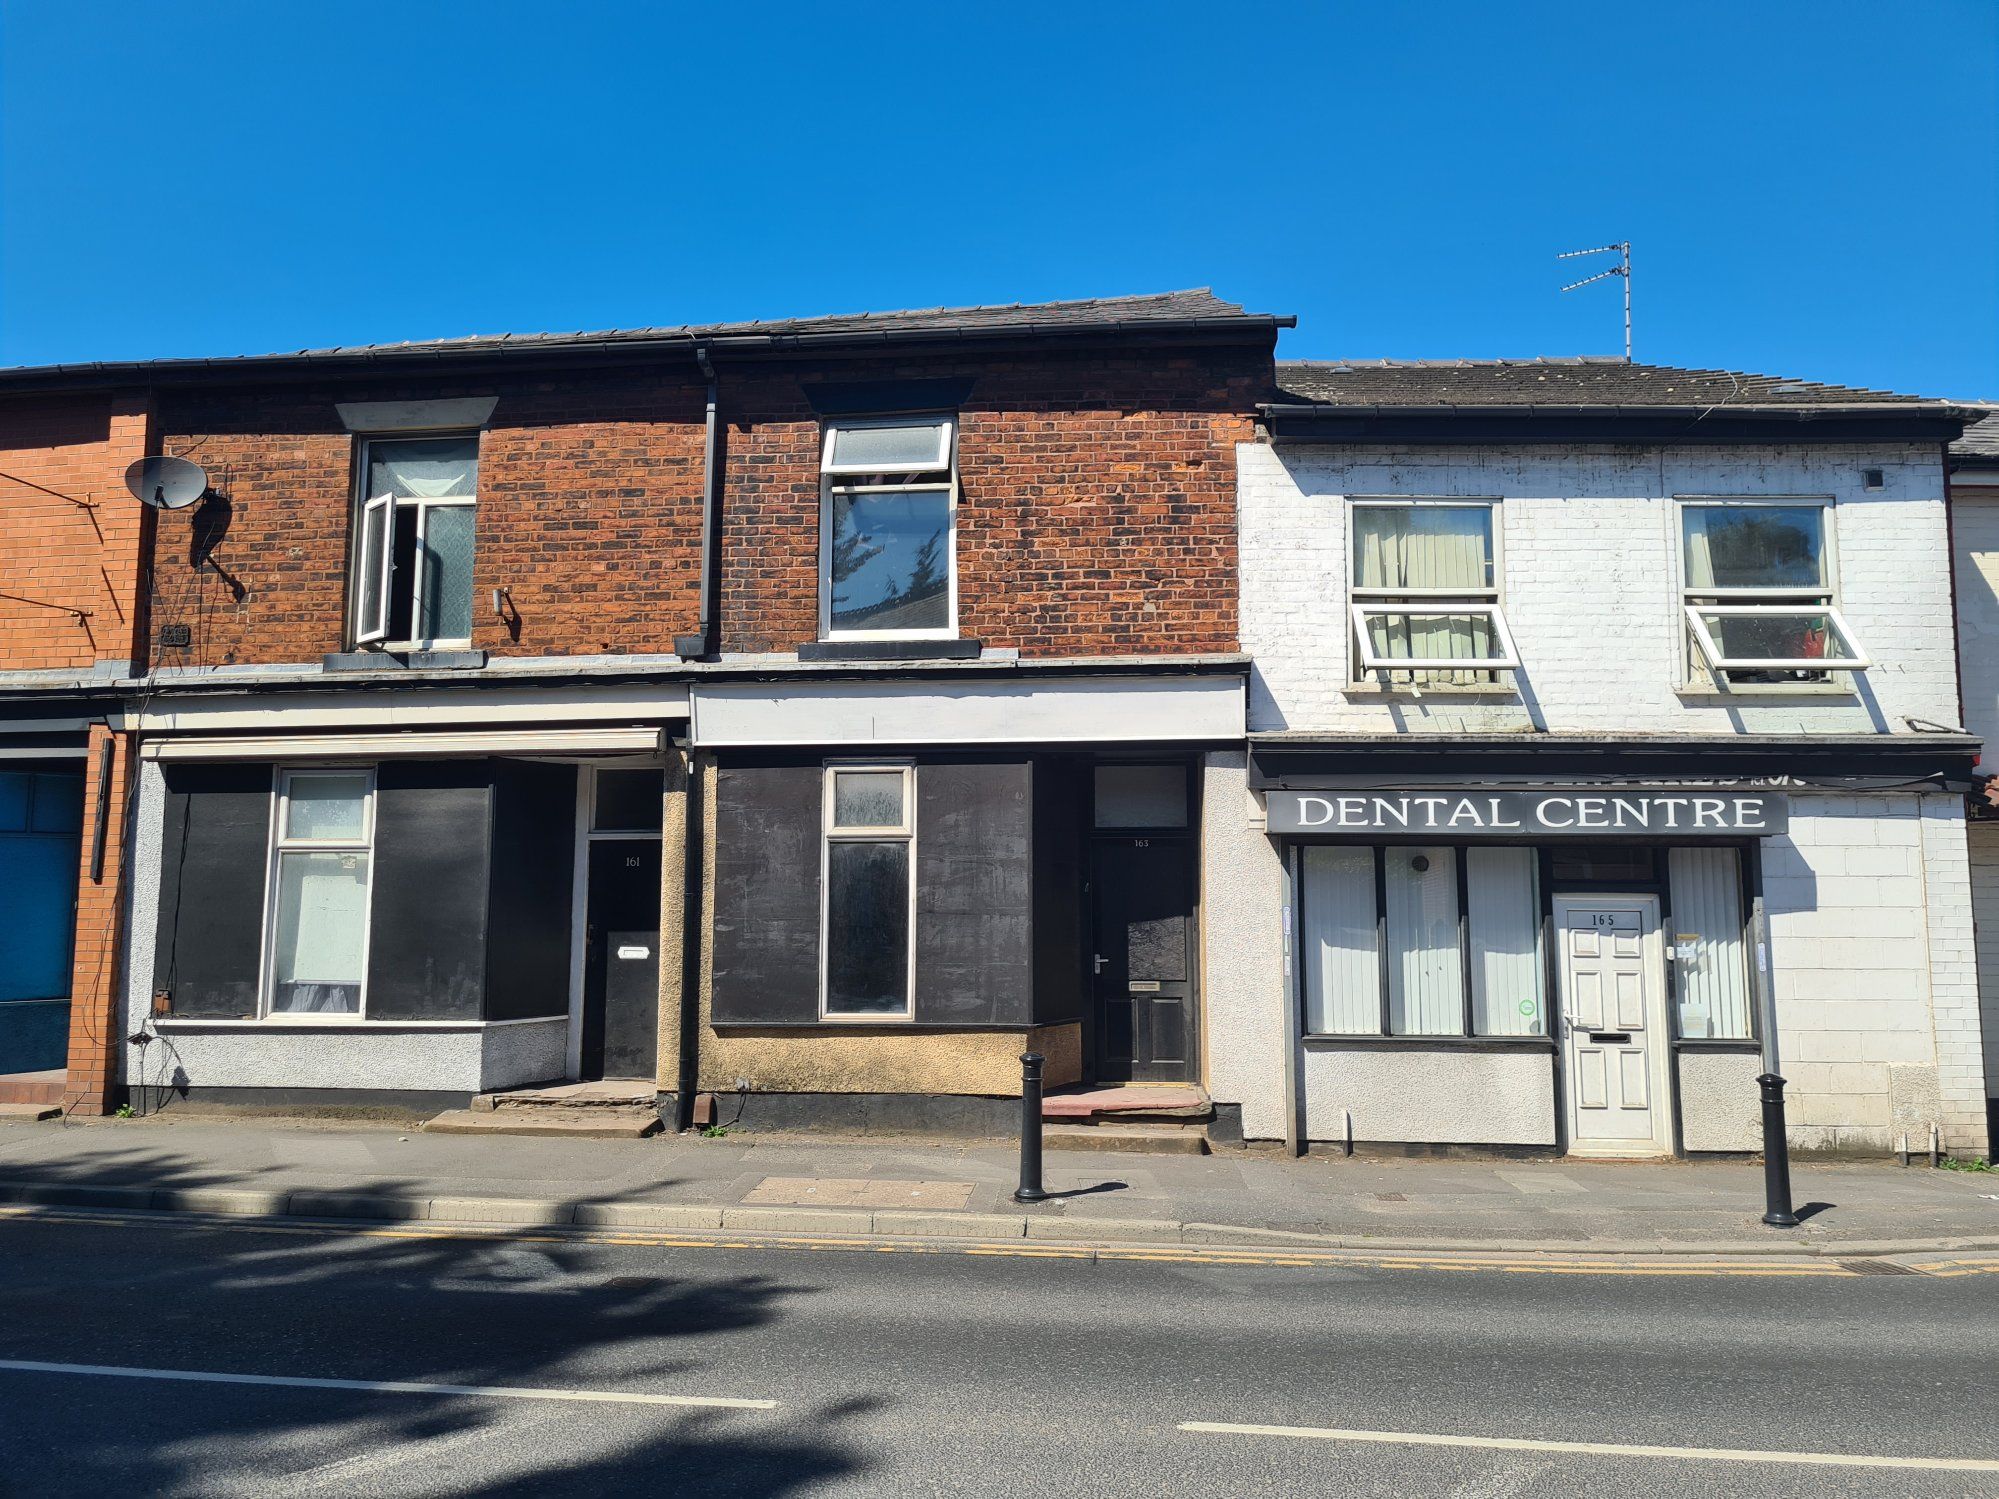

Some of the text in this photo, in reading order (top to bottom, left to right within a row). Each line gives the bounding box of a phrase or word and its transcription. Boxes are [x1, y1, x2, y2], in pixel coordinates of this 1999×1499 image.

[1297, 797, 1766, 828] DENTAL CENTRE
[1134, 839, 1149, 848] 163
[626, 856, 640, 867] 161
[1592, 914, 1614, 926] 165
